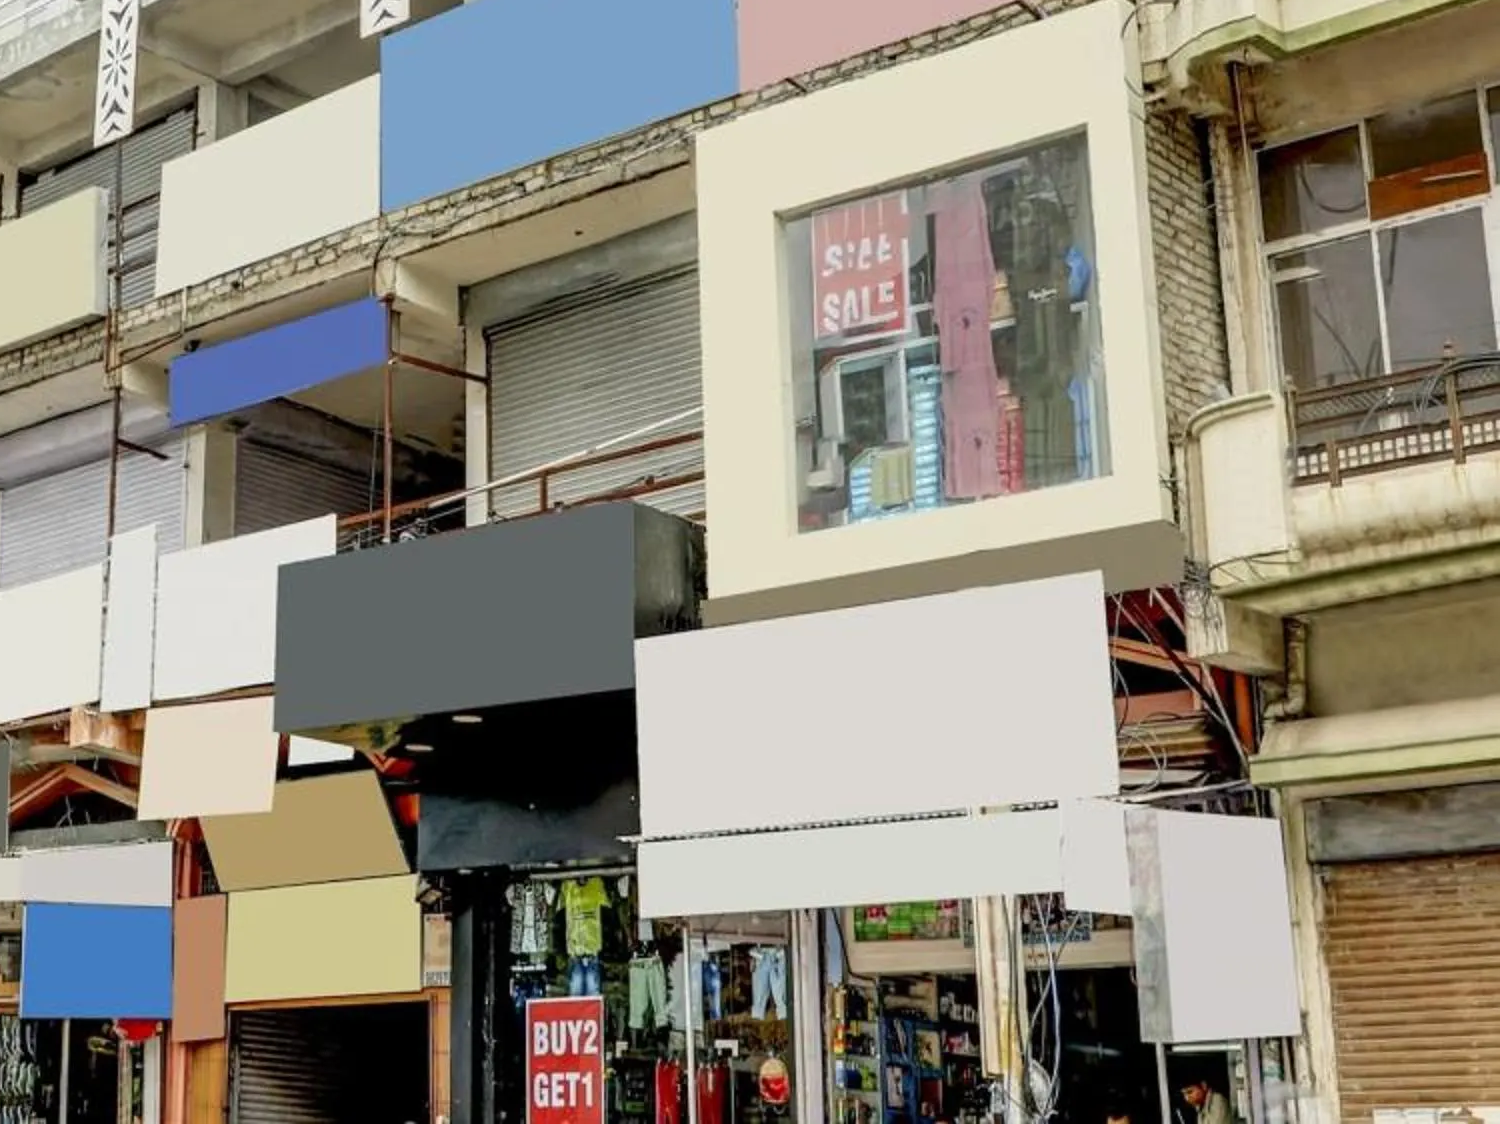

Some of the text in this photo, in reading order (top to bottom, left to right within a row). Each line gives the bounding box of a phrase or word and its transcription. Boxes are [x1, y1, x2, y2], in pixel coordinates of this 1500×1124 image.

[822, 280, 899, 332] SALE
[533, 1019, 599, 1056] BUY2
[533, 1071, 594, 1108] GET1
